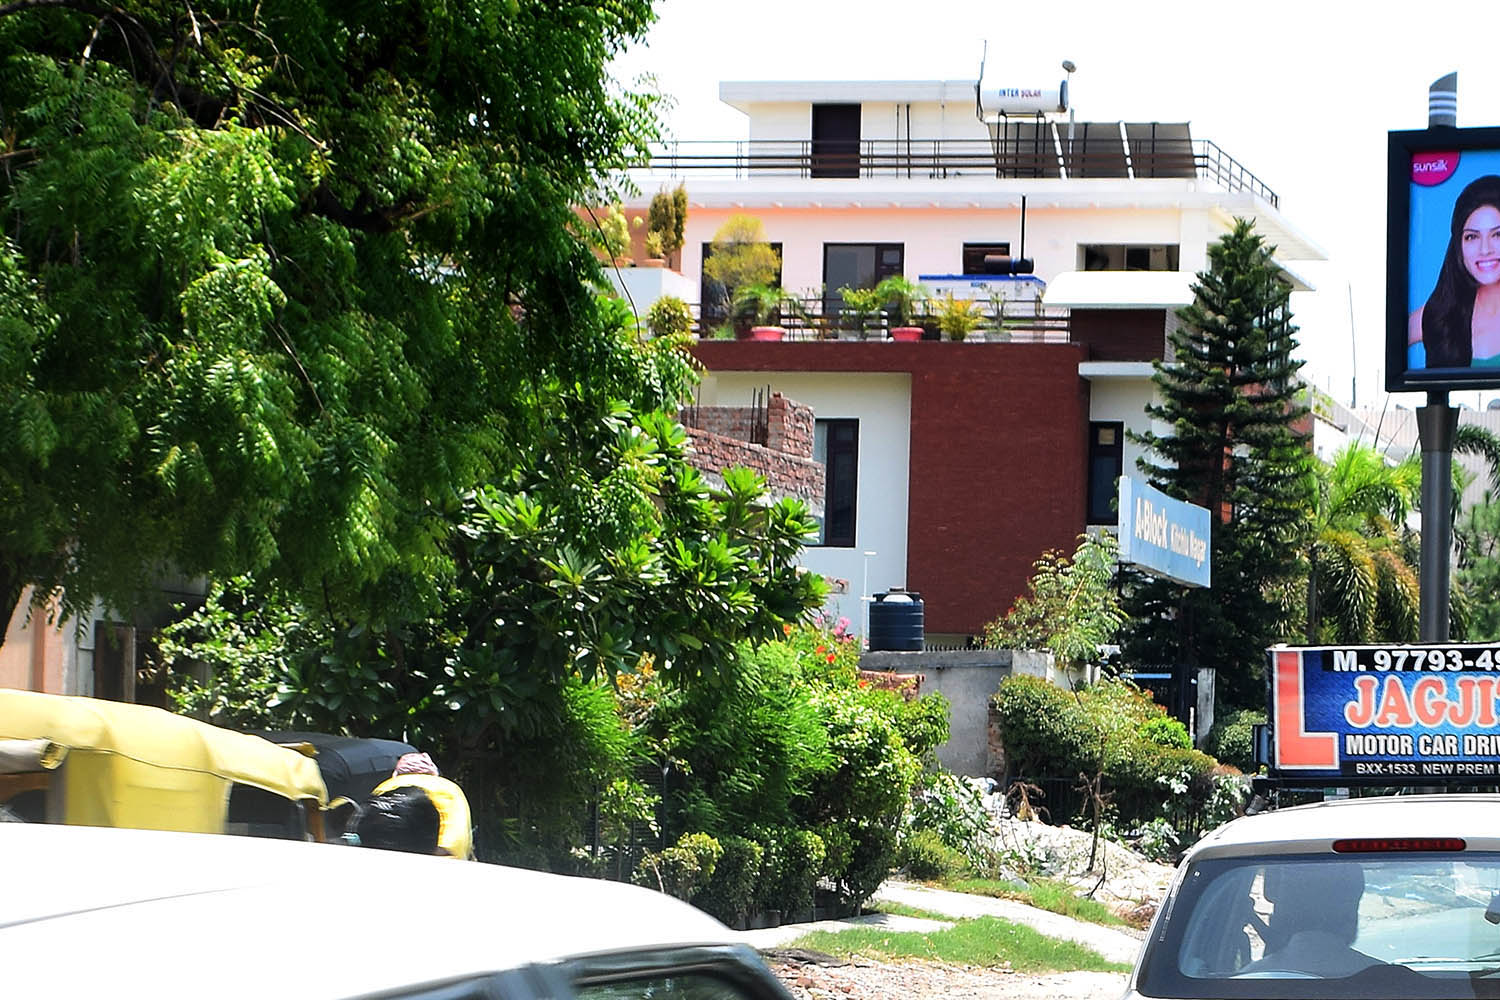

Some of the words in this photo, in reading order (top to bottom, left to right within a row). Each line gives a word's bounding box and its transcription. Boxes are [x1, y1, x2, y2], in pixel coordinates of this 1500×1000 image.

[999, 88, 1019, 97] INTER
[1333, 650, 1367, 672] M.
[1345, 734, 1414, 756] MOTOR
[1419, 734, 1458, 756] CAR
[1423, 763, 1453, 774] NEW
[1456, 763, 1495, 775] PREM
